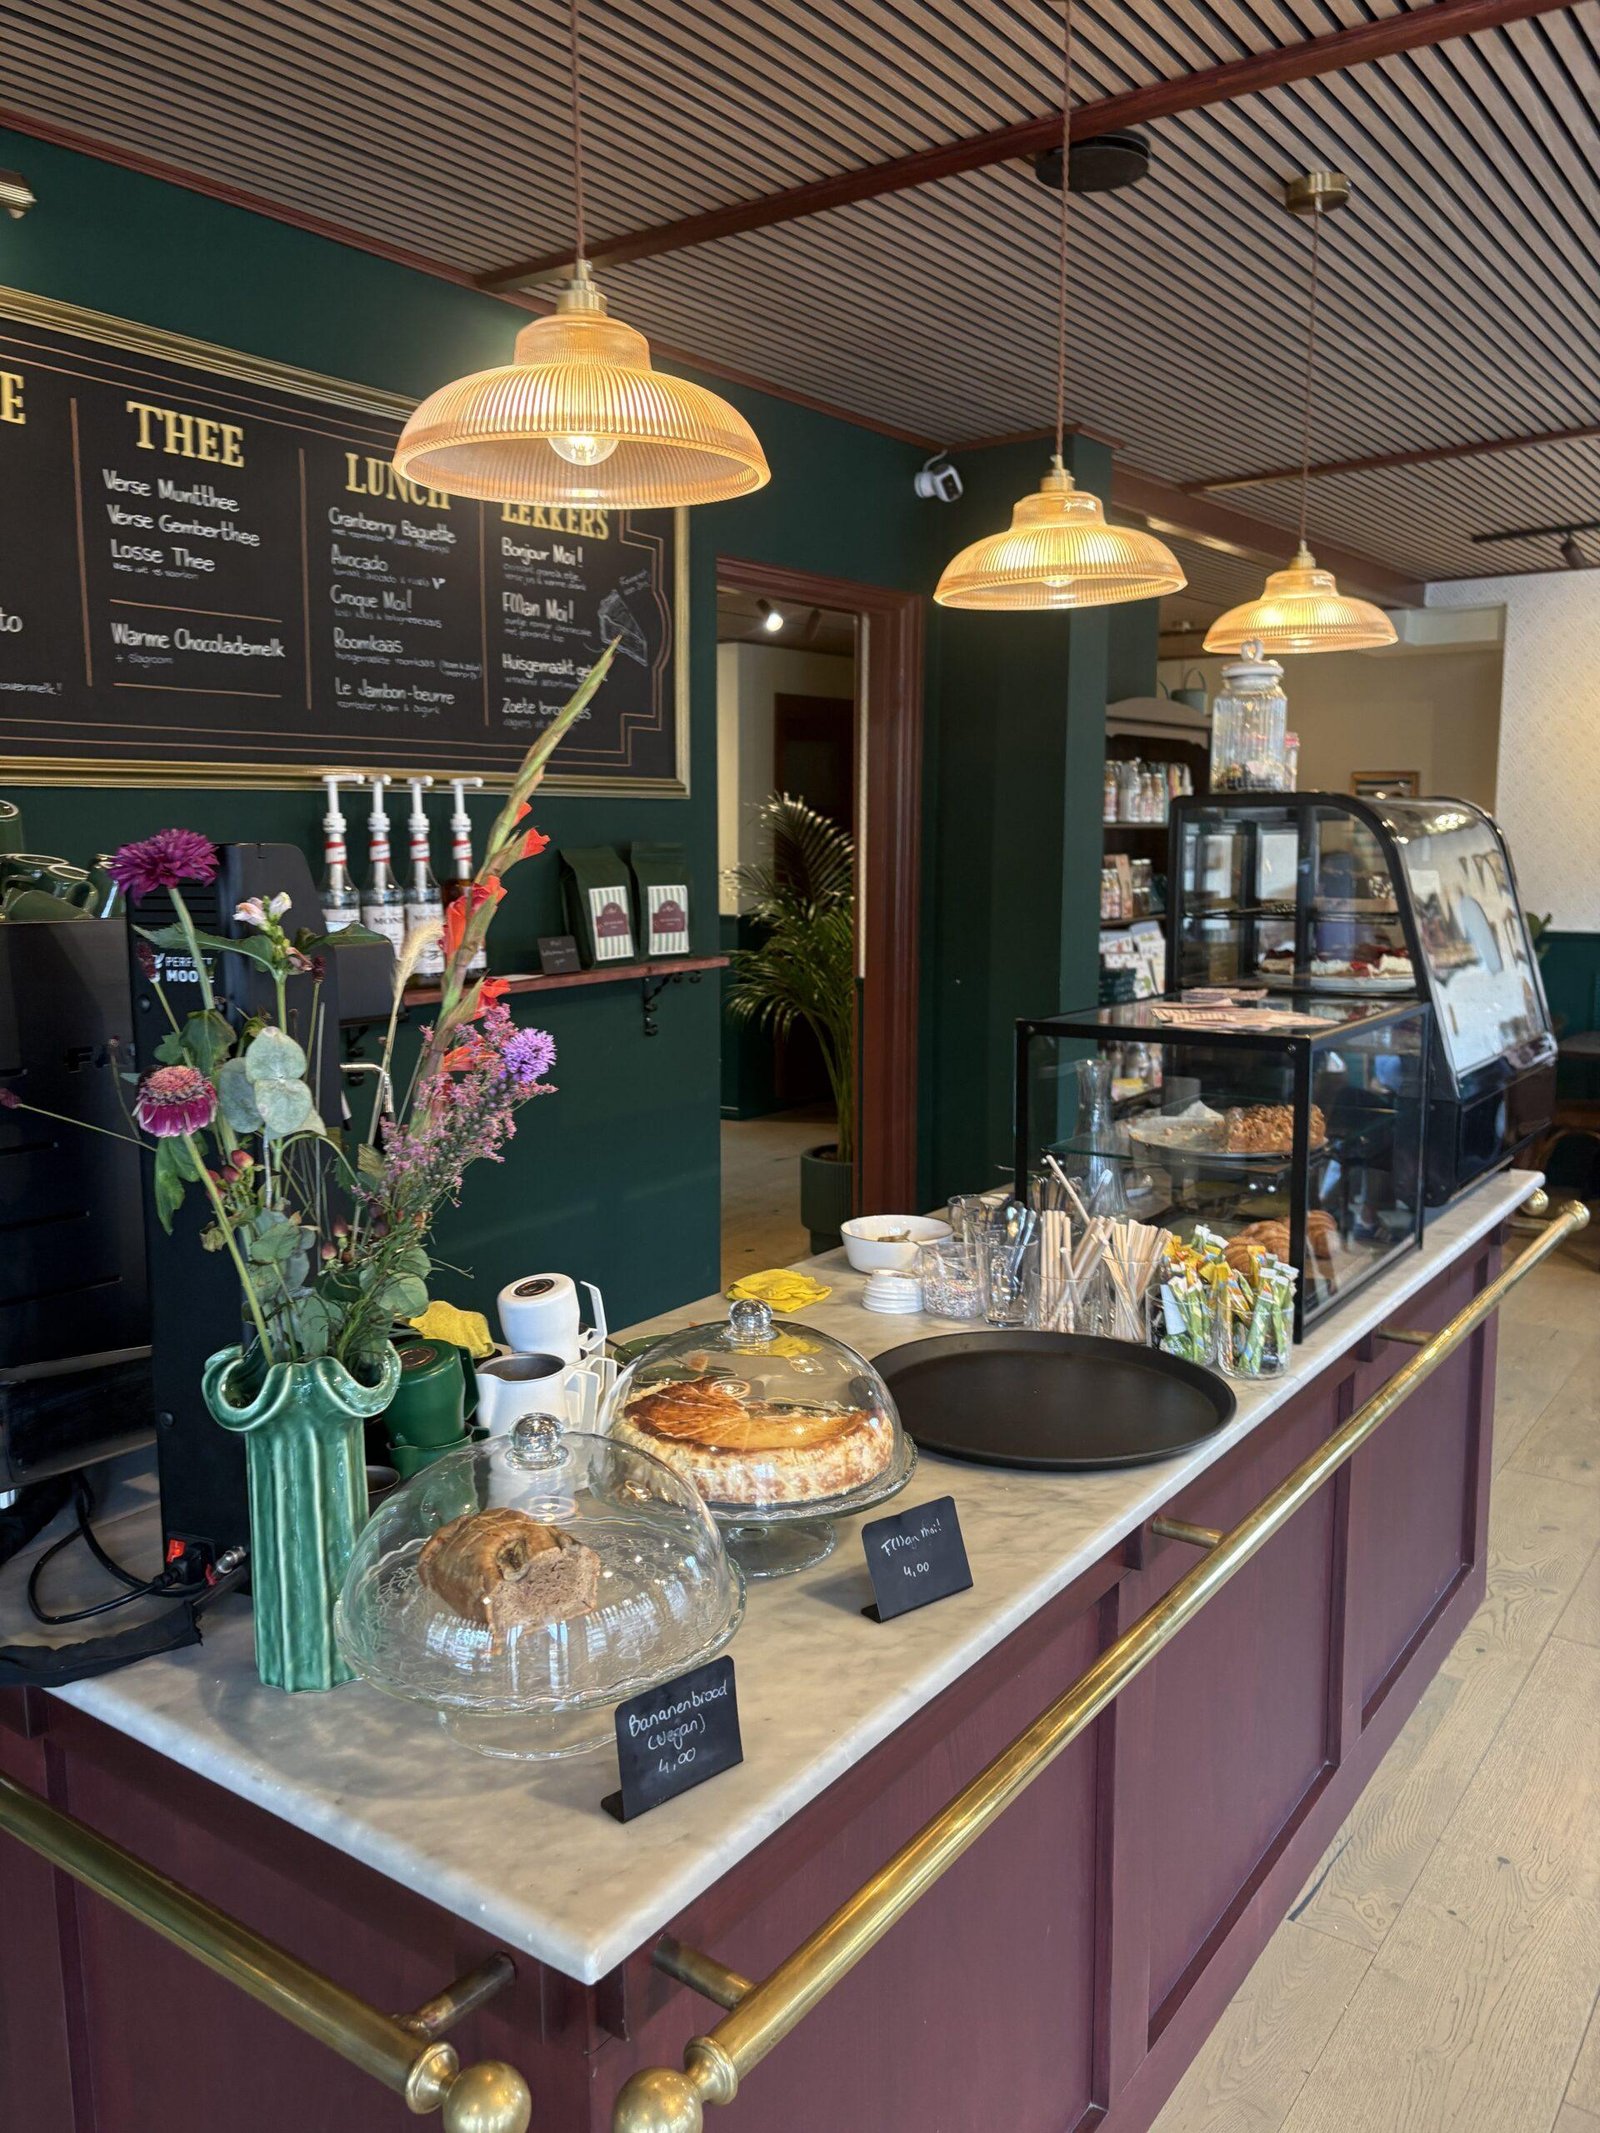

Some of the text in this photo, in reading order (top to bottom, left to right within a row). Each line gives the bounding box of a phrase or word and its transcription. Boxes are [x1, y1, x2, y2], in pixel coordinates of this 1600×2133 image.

[126, 400, 244, 468] THEE
[102, 468, 152, 497] Verse
[106, 503, 155, 529] Verse
[328, 507, 457, 545] Cranberry Baguette
[501, 503, 610, 540] LEKKERS
[110, 539, 216, 572] Losse Thee
[331, 543, 389, 572] Avocado
[501, 536, 583, 568] Bonjour Moi!
[329, 584, 378, 612] Croque
[546, 598, 574, 625] Moi!
[110, 622, 287, 657] Warme Chocolademelk
[333, 626, 404, 654] Roomkaas
[502, 652, 575, 679] Huisgemaakt
[334, 677, 456, 705] Le Jambon-beurre
[502, 696, 537, 715] Zoete
[165, 956, 214, 968] PERFT
[166, 969, 215, 983] MOOE
[903, 1561, 930, 1578] 4,00
[628, 1679, 728, 1737] Bananenbrood
[658, 1747, 696, 1774] 4,00
